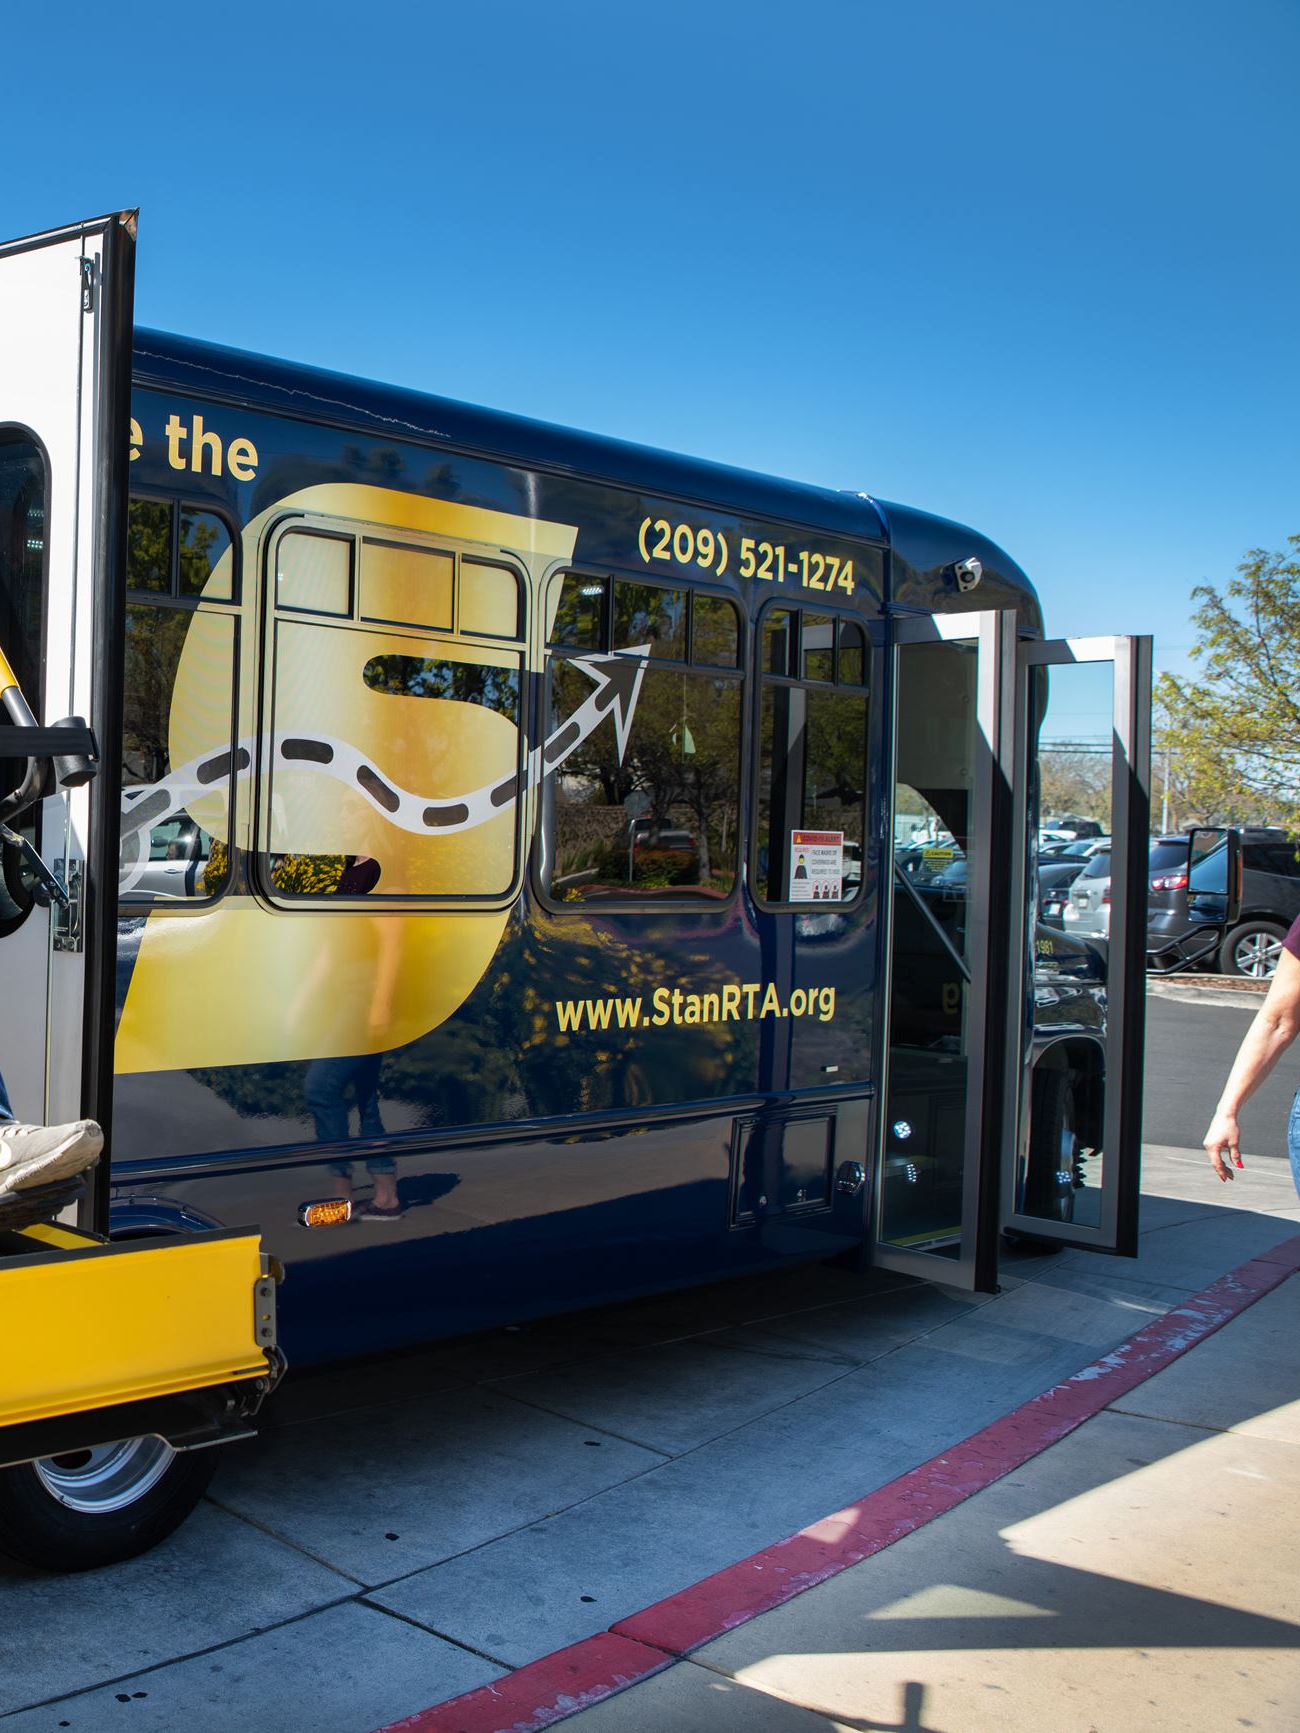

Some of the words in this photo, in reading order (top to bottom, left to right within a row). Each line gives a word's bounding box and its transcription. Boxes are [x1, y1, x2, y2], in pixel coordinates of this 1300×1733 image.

[165, 415, 258, 481] the
[638, 517, 728, 577] (209)
[739, 537, 855, 596] 521-1274
[556, 982, 836, 1032] www.StanRTA.org
